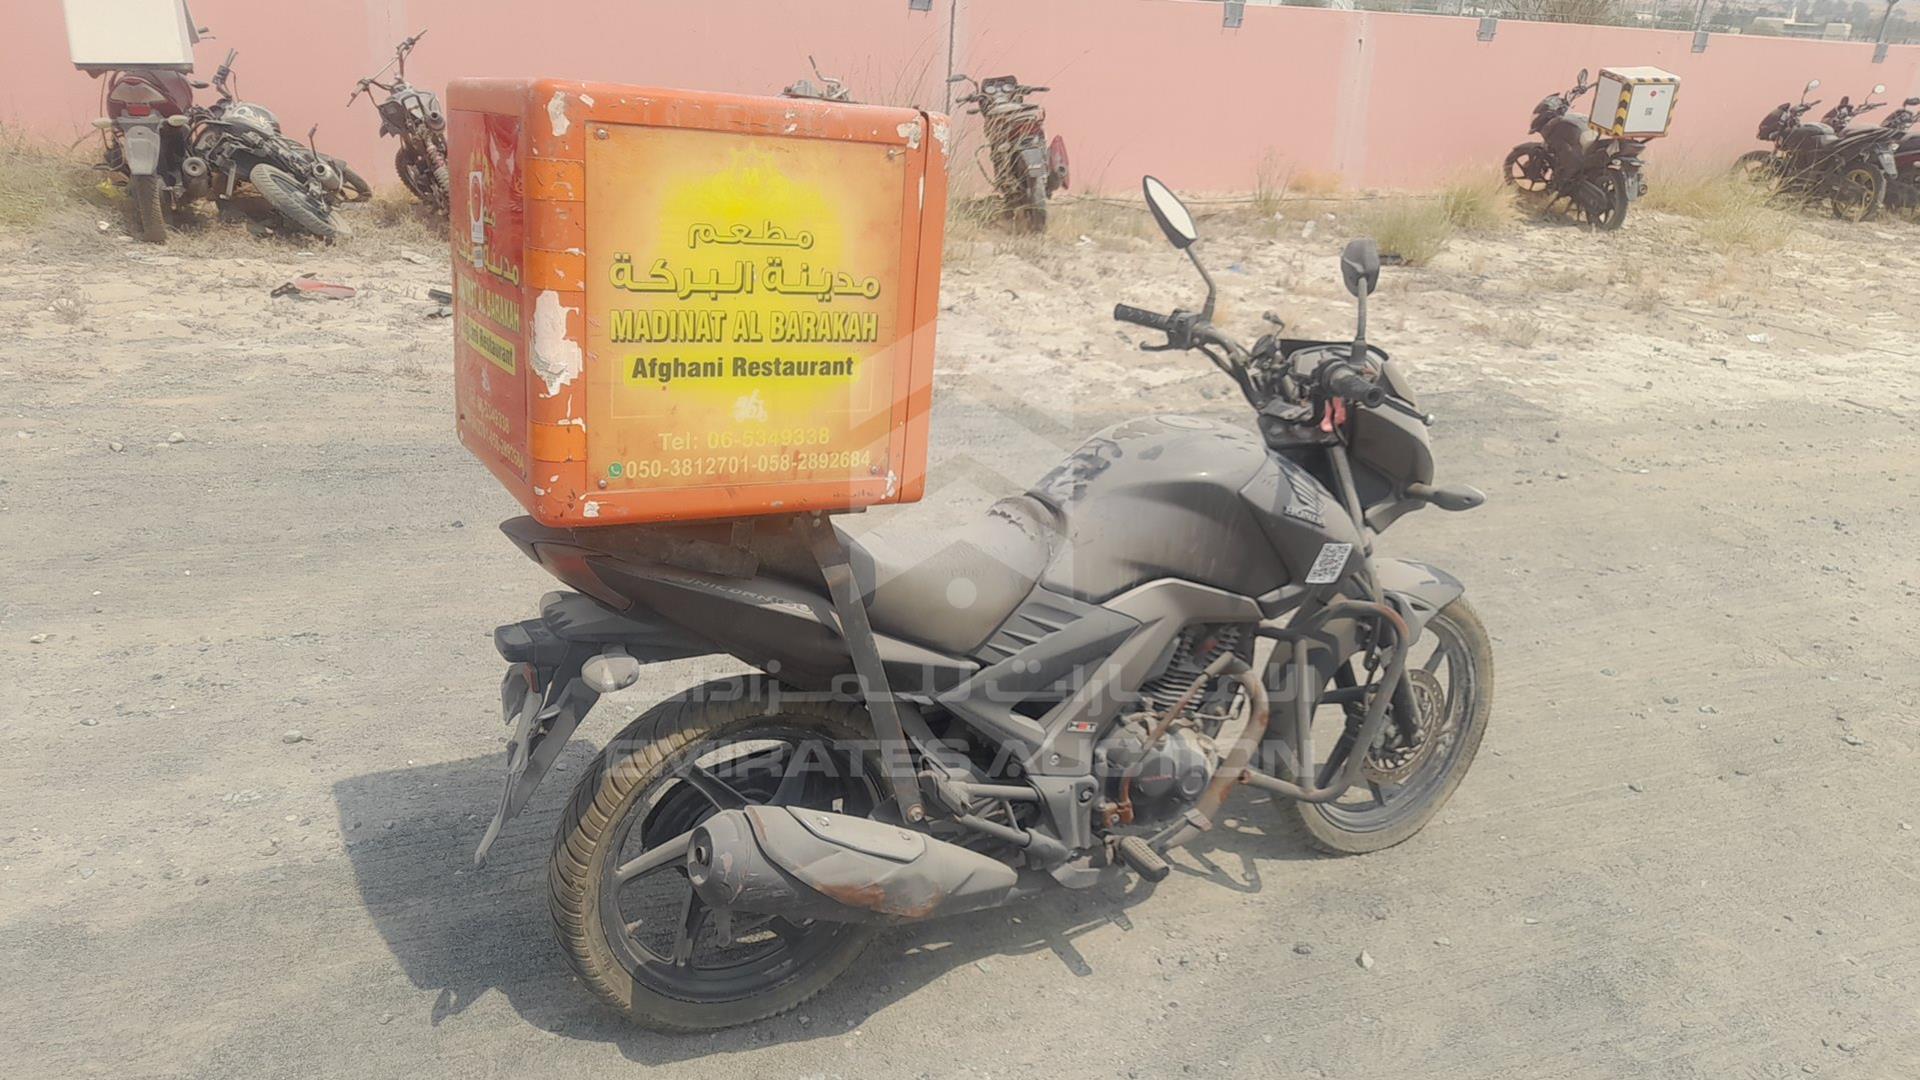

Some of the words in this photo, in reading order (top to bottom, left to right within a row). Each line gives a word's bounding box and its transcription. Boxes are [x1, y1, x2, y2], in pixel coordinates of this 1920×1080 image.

[688, 219, 814, 250] مطعم
[608, 252, 755, 301] البركة
[761, 257, 881, 302] مدينة
[609, 309, 727, 344] MADINAT
[732, 310, 764, 344] AL
[769, 311, 879, 344] BARAKAH
[632, 357, 723, 382] Afghani
[732, 356, 854, 378] Restaurant
[658, 432, 698, 451] Tel:
[707, 427, 830, 450] 06-5349338
[626, 450, 872, 479] 050-3812701-058-2892684
